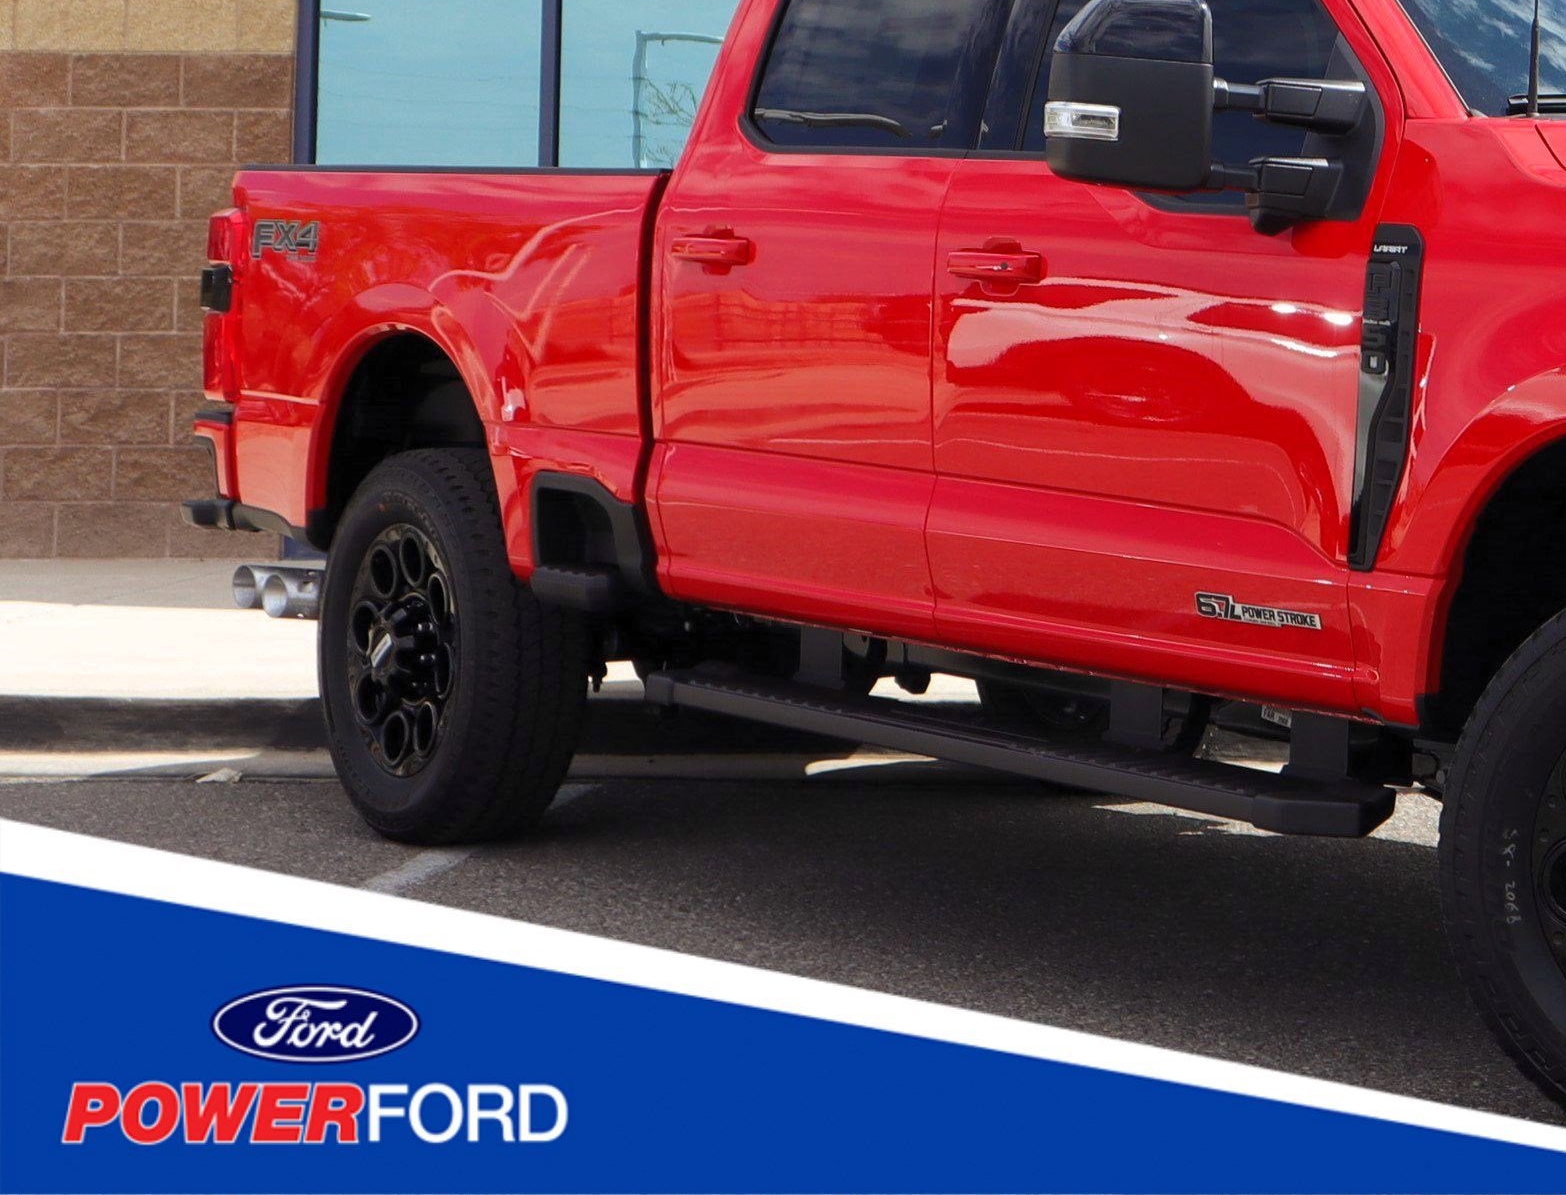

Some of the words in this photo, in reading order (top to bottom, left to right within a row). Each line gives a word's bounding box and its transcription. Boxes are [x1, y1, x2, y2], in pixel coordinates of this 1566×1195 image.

[251, 219, 320, 260] FX4
[1241, 606, 1277, 622] POWER
[1277, 611, 1318, 628] STROKE
